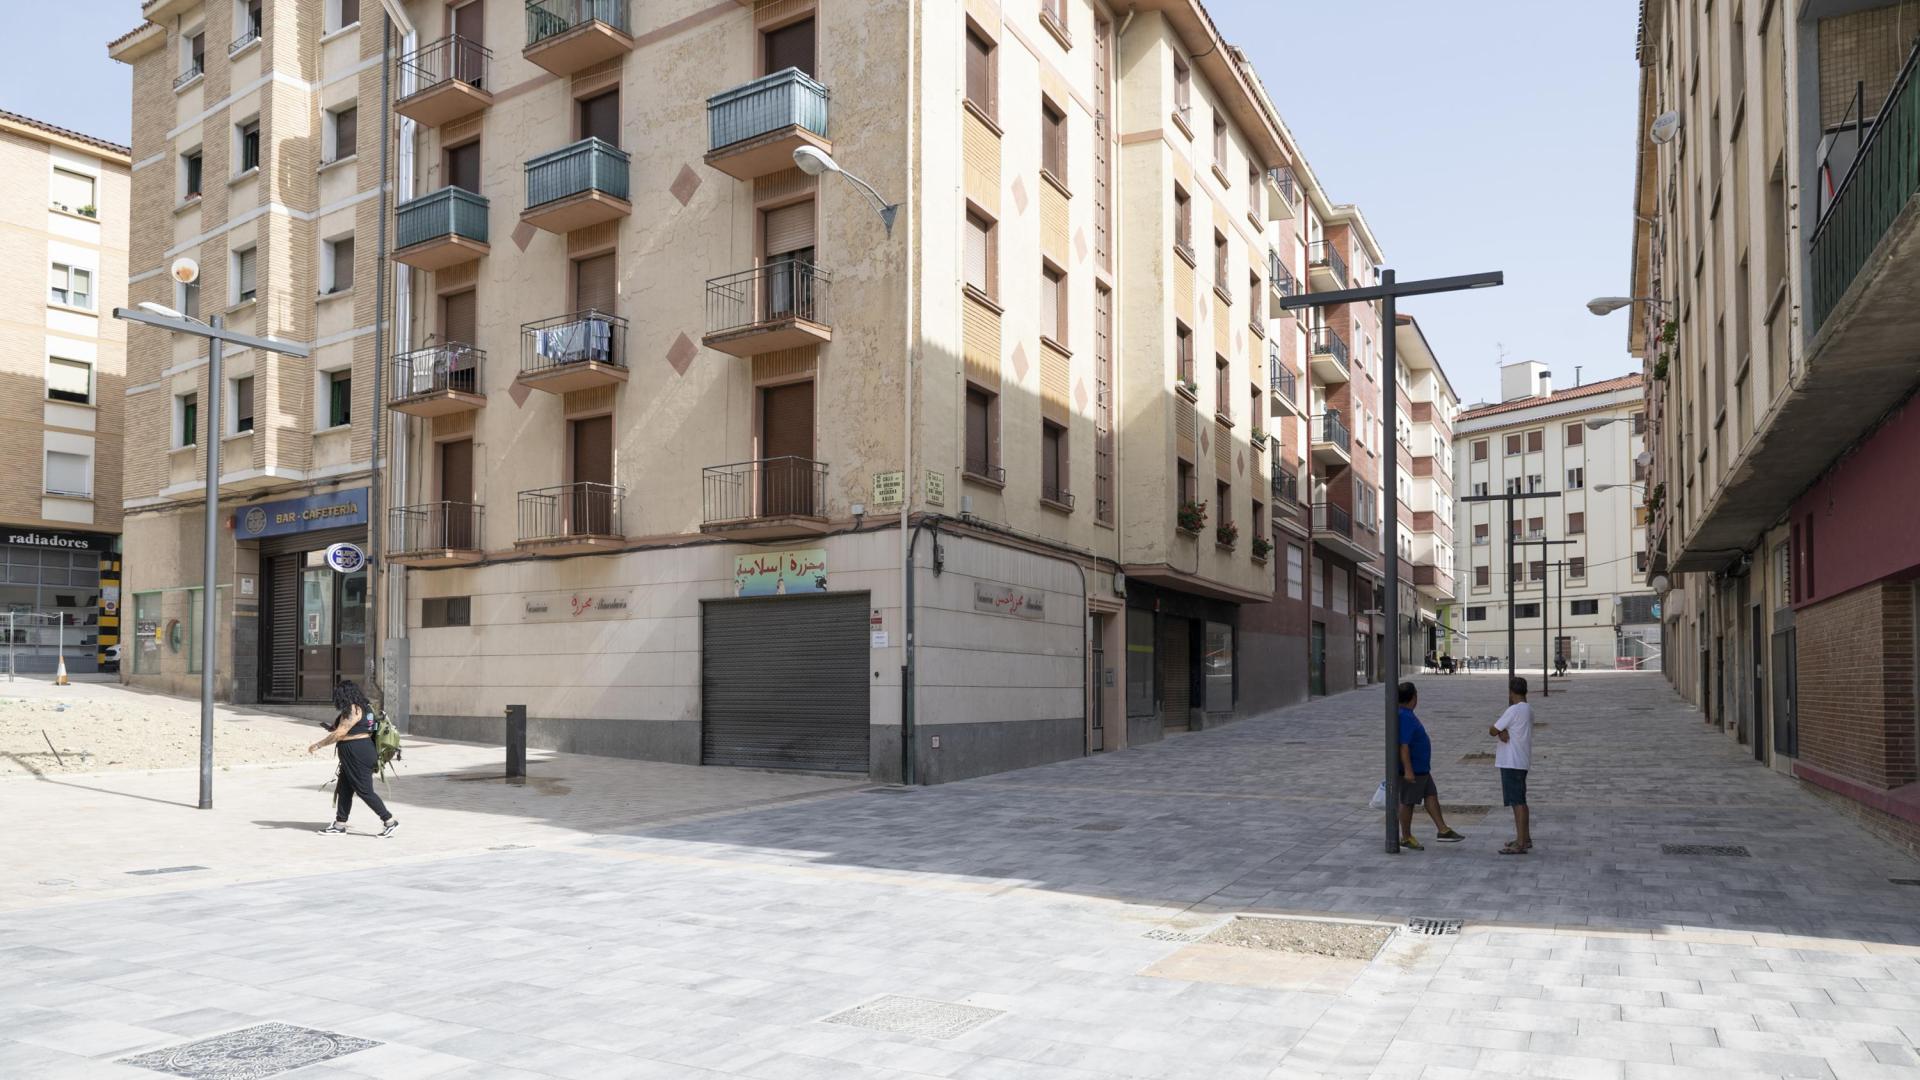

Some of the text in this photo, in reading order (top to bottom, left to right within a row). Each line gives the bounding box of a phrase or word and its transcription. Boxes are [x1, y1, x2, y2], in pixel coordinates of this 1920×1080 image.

[276, 512, 296, 524] BAR
[302, 502, 358, 520] CAFETERÍA
[8, 533, 89, 549] radiadores
[790, 553, 825, 576] مجزرة
